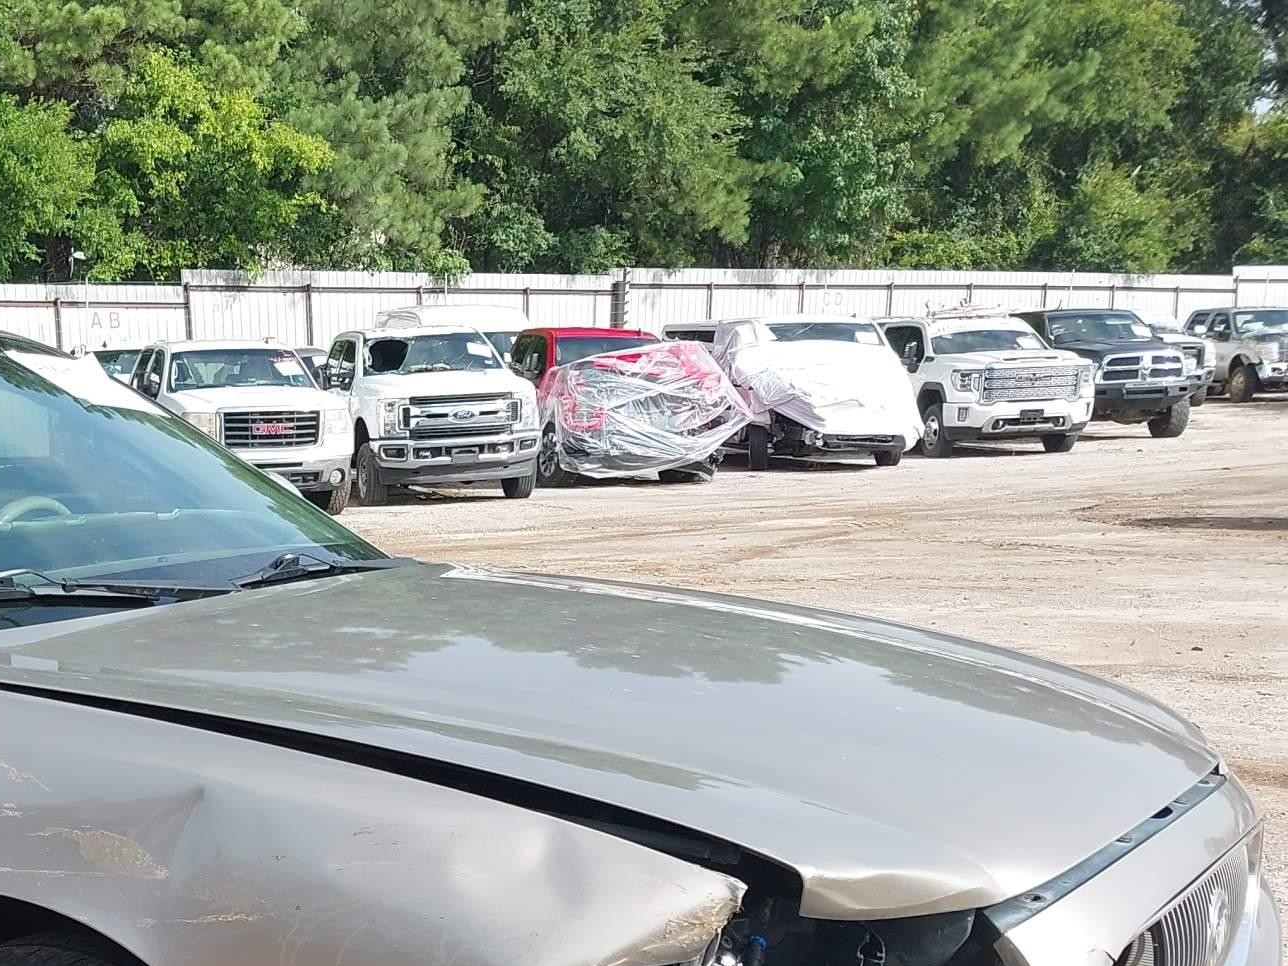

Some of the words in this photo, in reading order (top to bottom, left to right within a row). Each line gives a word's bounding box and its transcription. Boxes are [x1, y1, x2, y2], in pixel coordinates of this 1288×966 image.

[91, 311, 103, 329] A
[109, 311, 121, 329] B
[252, 422, 294, 435] GMC
